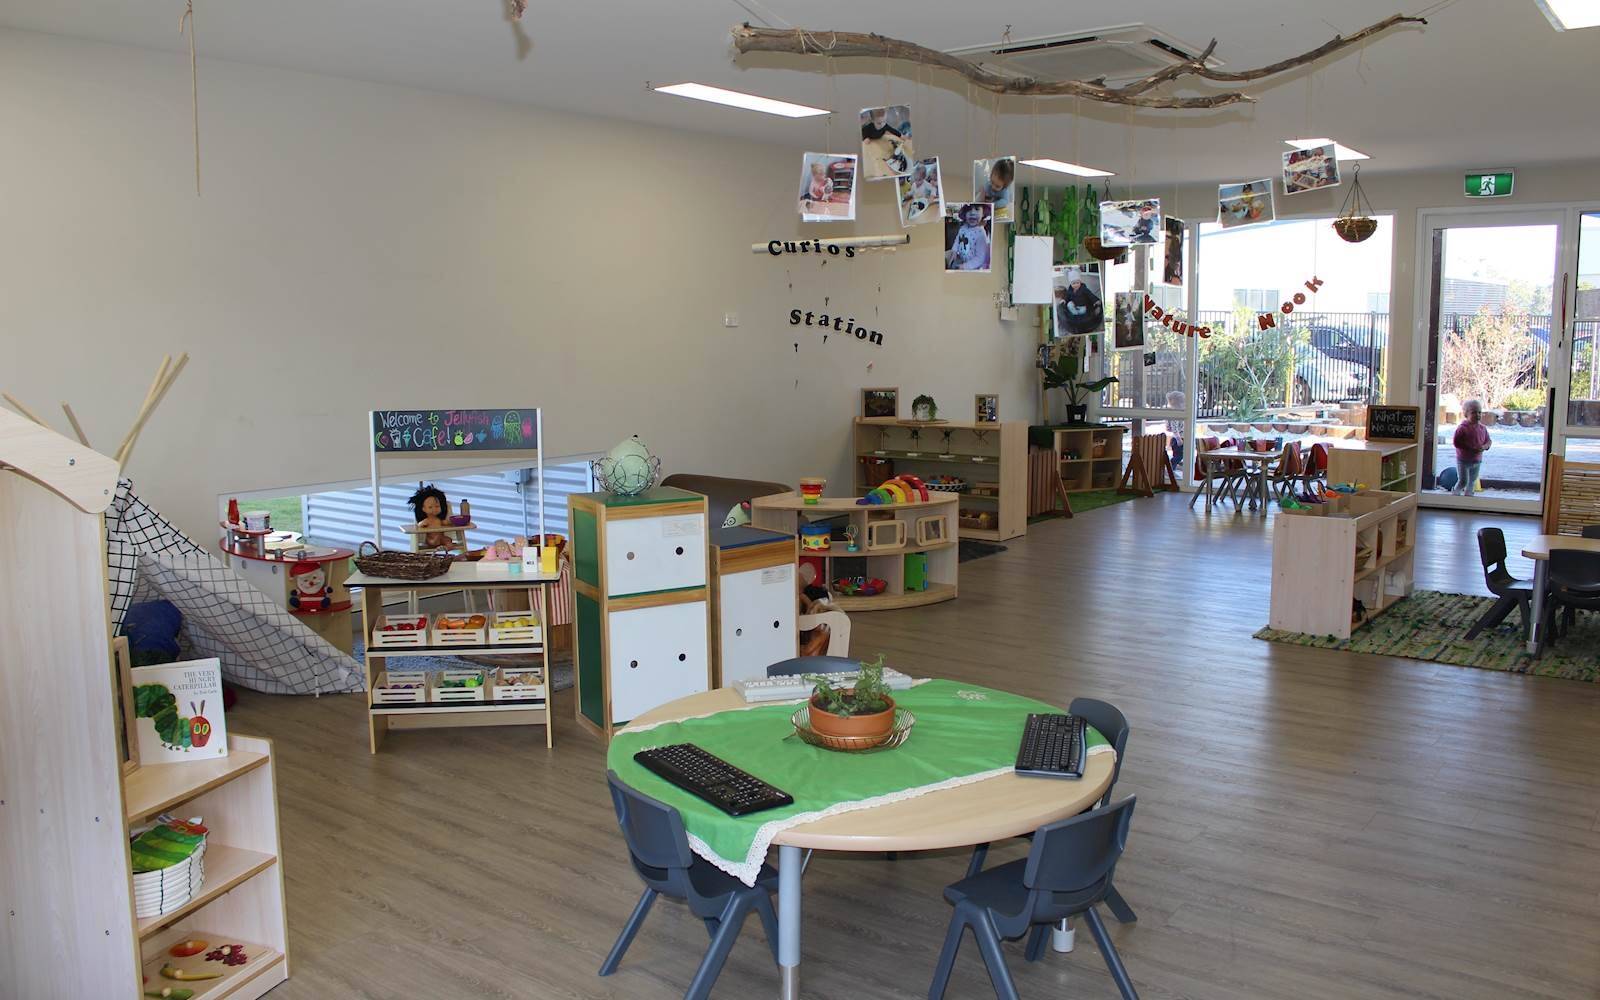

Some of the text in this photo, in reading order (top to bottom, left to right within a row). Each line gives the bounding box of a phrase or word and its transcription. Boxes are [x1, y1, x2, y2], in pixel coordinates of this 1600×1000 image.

[768, 239, 855, 258] Curios
[1257, 275, 1324, 331] Nook
[789, 309, 884, 345] Station
[380, 411, 423, 429] Welcome
[428, 412, 440, 425] to
[173, 681, 217, 690] CATERPILLAR
